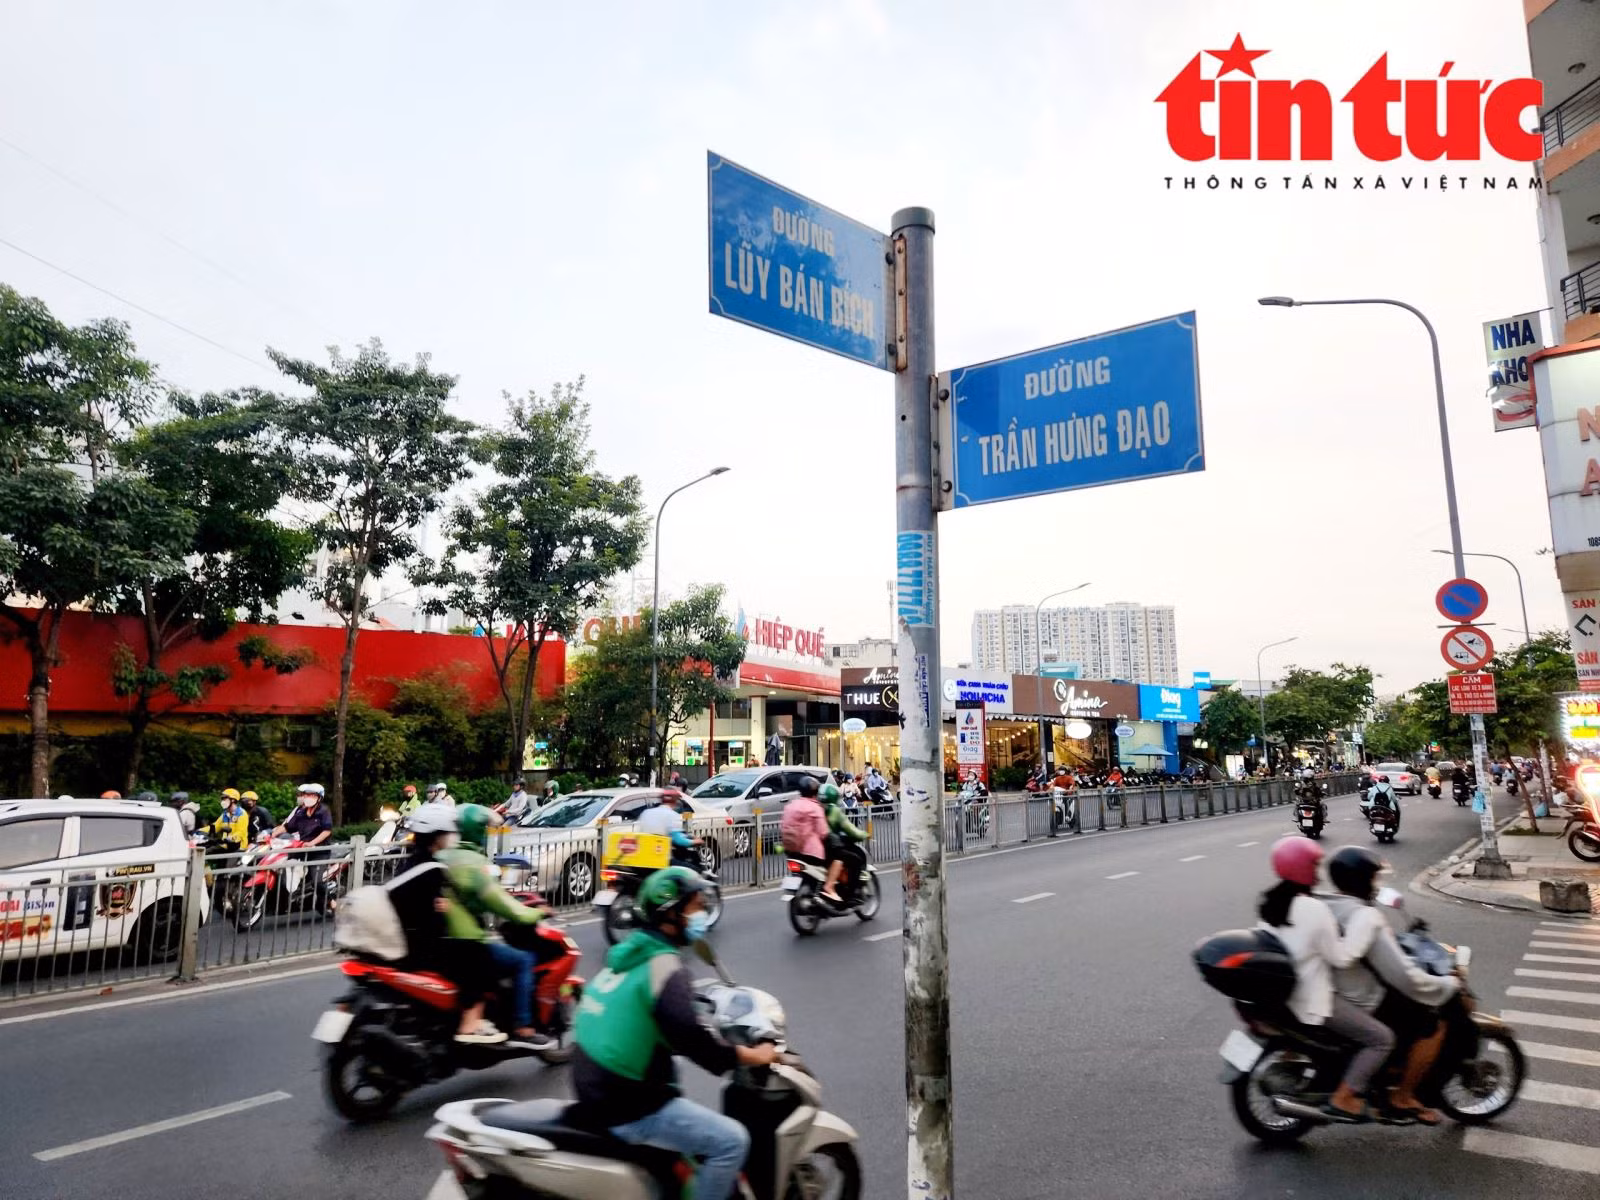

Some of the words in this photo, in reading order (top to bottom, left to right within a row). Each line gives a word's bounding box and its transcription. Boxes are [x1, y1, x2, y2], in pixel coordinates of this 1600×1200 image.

[772, 205, 836, 257] ĐƯỜNG
[725, 240, 771, 301] LŨY
[779, 263, 825, 322] BÁN
[831, 280, 875, 340] BÍCH
[1491, 319, 1537, 351] NHA
[1024, 356, 1111, 400] ĐƯỜNG
[978, 416, 1038, 476] TRẦN
[1044, 412, 1108, 465] HƯNG
[1117, 400, 1171, 459] ĐẠO
[755, 616, 793, 654] HIỆP
[795, 627, 825, 660] QUẾ
[1060, 686, 1108, 715] Amina
